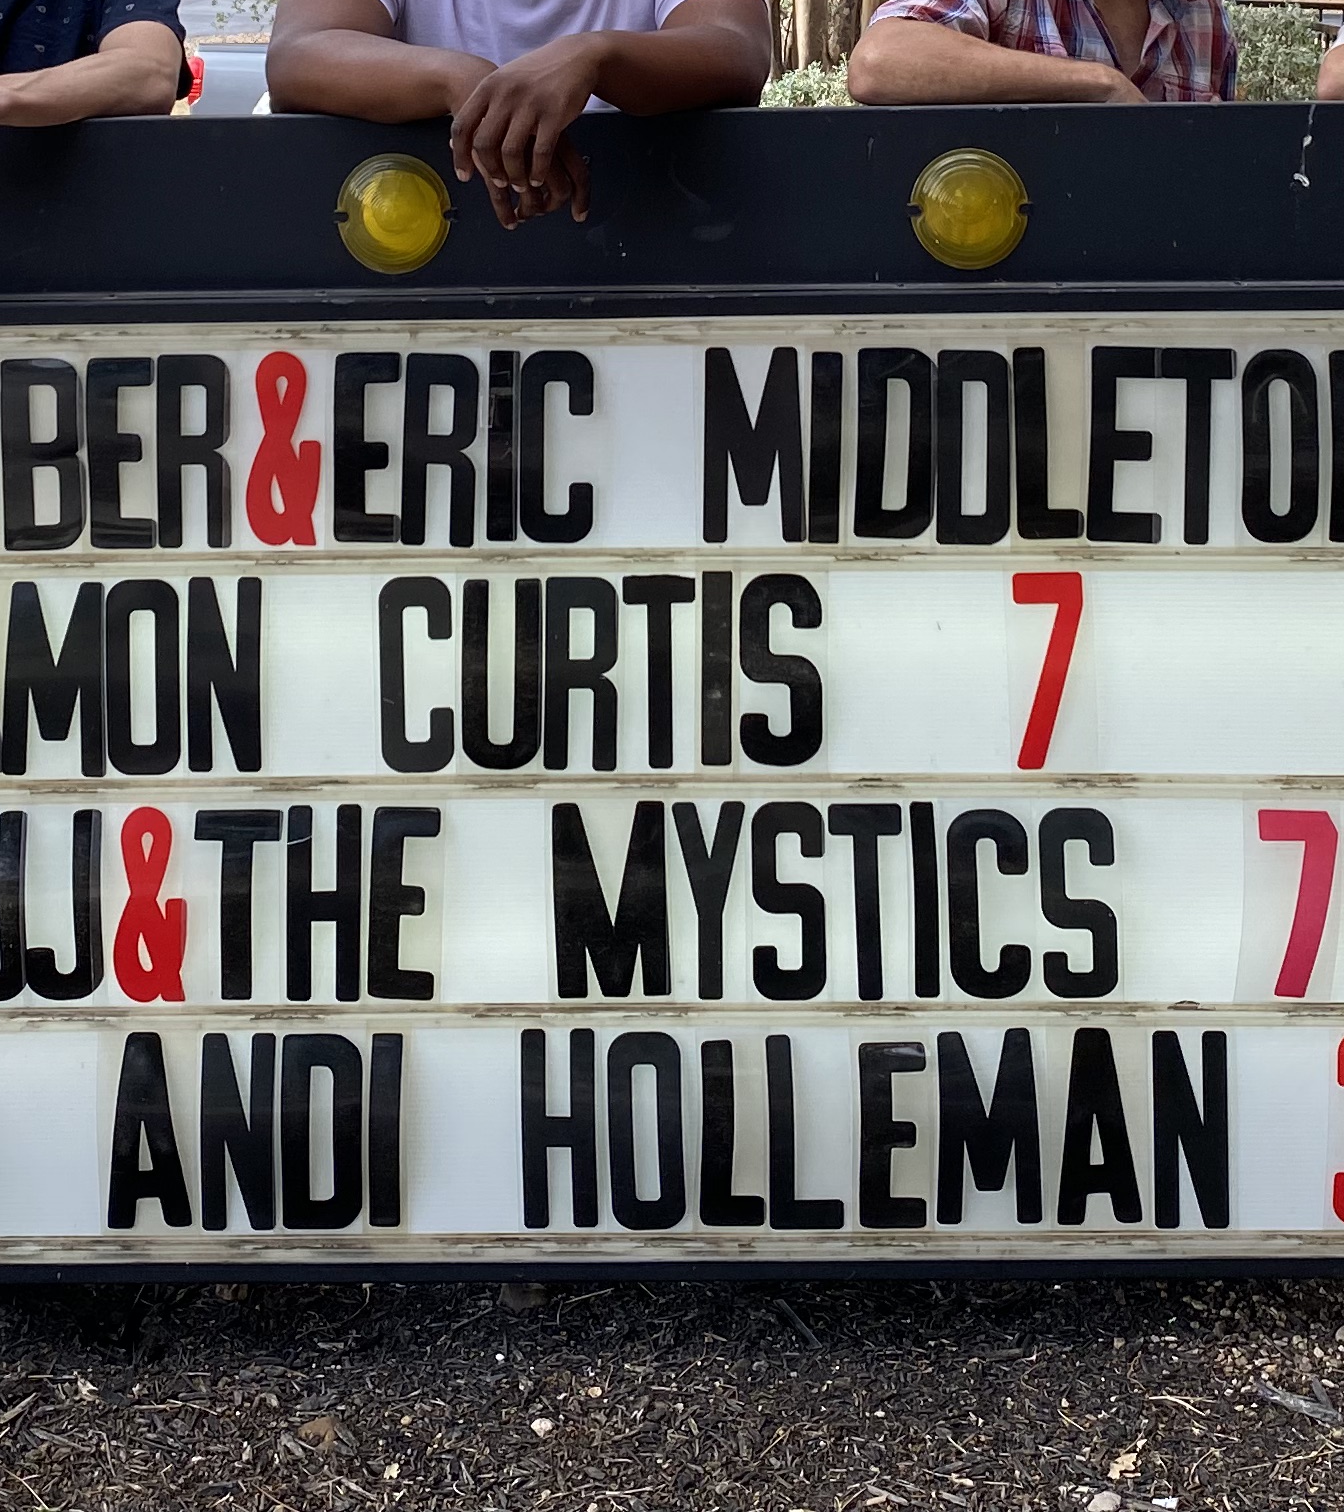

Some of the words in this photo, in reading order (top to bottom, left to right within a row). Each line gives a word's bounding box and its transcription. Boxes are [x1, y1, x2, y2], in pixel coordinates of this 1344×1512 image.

[379, 571, 823, 772] CURTIS
[1013, 572, 1083, 770] 7
[552, 801, 1119, 1001] MYSTICS
[1258, 809, 1339, 998] 7
[108, 1031, 403, 1231] ANDI
[521, 1027, 1229, 1230] HOLLEMAN
